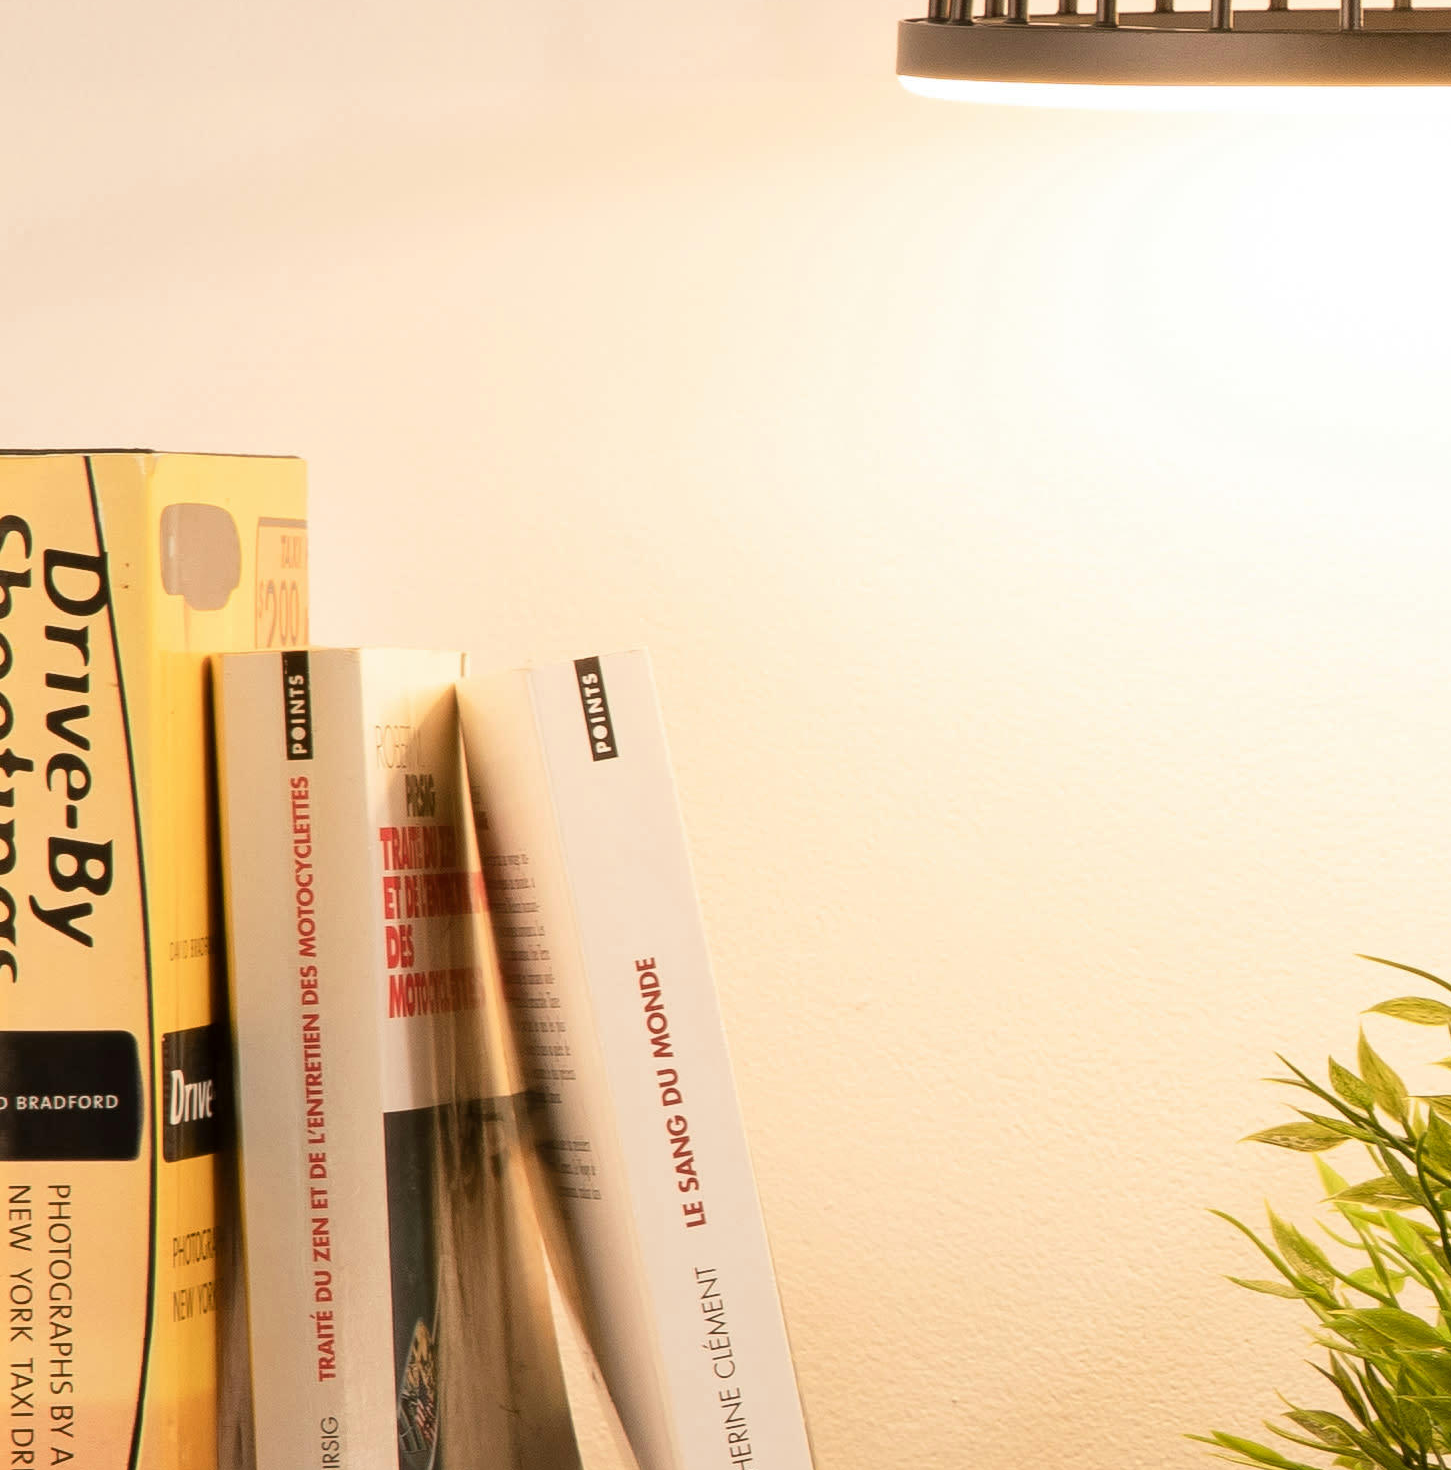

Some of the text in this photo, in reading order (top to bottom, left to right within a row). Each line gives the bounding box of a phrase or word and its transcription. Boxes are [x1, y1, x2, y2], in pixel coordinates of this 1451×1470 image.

[29, 548, 114, 948] Drive-By
[287, 674, 308, 755] POINTS
[582, 673, 613, 754] POINTS
[383, 876, 401, 920] ET
[385, 924, 415, 970] DES
[16, 1094, 119, 1111] BRADFORD
[290, 775, 337, 1382] TRAITÉ DU ZEN ET DE L'ENTRETIEN DES MOTOCYCLETTES
[635, 957, 707, 1228] LE SANG DU MONDE
[8, 1185, 33, 1252] NEW
[10, 1268, 34, 1342] YORK
[47, 1185, 75, 1466] PHOTOGRAPHS BY A
[694, 1266, 737, 1379] CLÉMENT
[10, 1358, 34, 1417] TAXI
